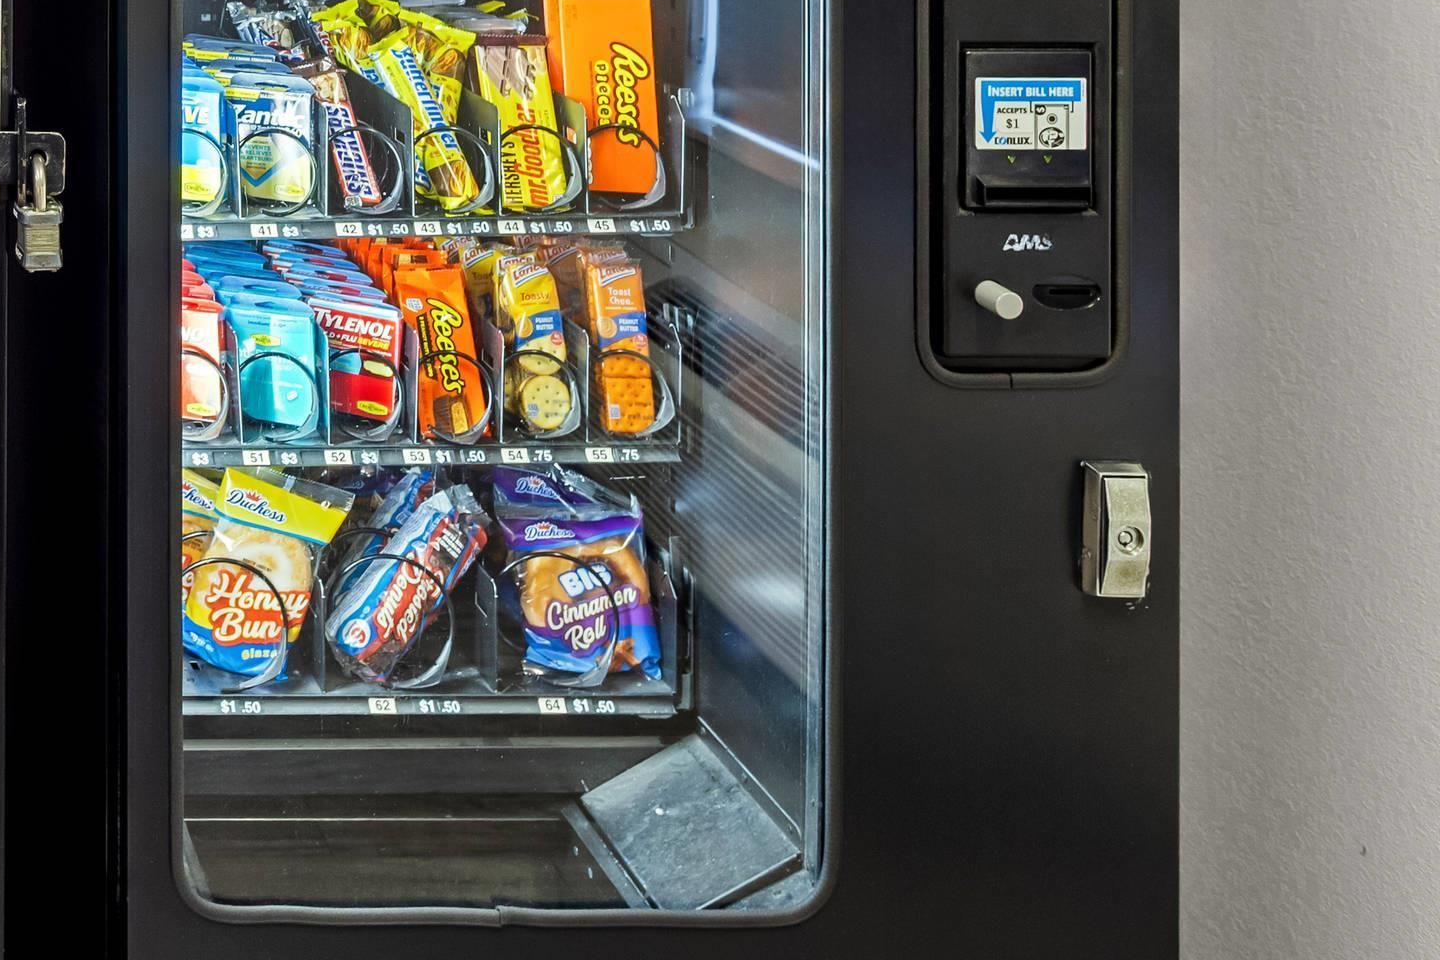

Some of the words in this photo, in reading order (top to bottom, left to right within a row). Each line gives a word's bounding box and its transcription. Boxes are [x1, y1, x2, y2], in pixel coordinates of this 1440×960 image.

[987, 85, 1023, 97] INSERT
[1025, 86, 1047, 97] BILL
[1048, 87, 1074, 97] HERE
[1006, 117, 1020, 129] $1
[501, 141, 524, 204] HERSHEY'S
[258, 226, 271, 235] 41
[342, 225, 356, 234] 42
[368, 225, 383, 235] $1
[389, 224, 408, 234] .50
[421, 223, 436, 233] 43
[447, 222, 462, 234] $1
[470, 222, 489, 233] .50
[504, 222, 520, 231] 44
[530, 222, 545, 233] $1
[553, 221, 573, 232] .50
[595, 220, 610, 231] 45
[630, 220, 645, 232] $1
[651, 220, 670, 231] .50
[608, 287, 631, 297] Toast
[314, 307, 394, 339] TYLENOL
[341, 334, 358, 343] FLU
[358, 337, 390, 350] SEVERE
[250, 453, 264, 462] 51
[331, 452, 346, 462] 52
[410, 451, 425, 461] 53
[436, 449, 451, 462] $1
[467, 450, 485, 461] .50
[508, 450, 523, 460] 54
[533, 449, 552, 461] .75
[593, 449, 608, 459] 55
[621, 449, 639, 460] .75
[226, 489, 285, 522] Duchess
[525, 525, 575, 540] Duchess
[560, 565, 611, 597] BIG
[548, 586, 637, 630] Cinnamon
[212, 607, 282, 642] Bun
[565, 619, 607, 650] Roll
[221, 701, 236, 713] $1
[241, 701, 260, 713] .50
[375, 701, 390, 710] 62
[420, 701, 435, 712] $1
[441, 701, 460, 712] .50
[545, 700, 560, 710] 64
[573, 700, 589, 712] $1
[596, 700, 615, 712] .50
